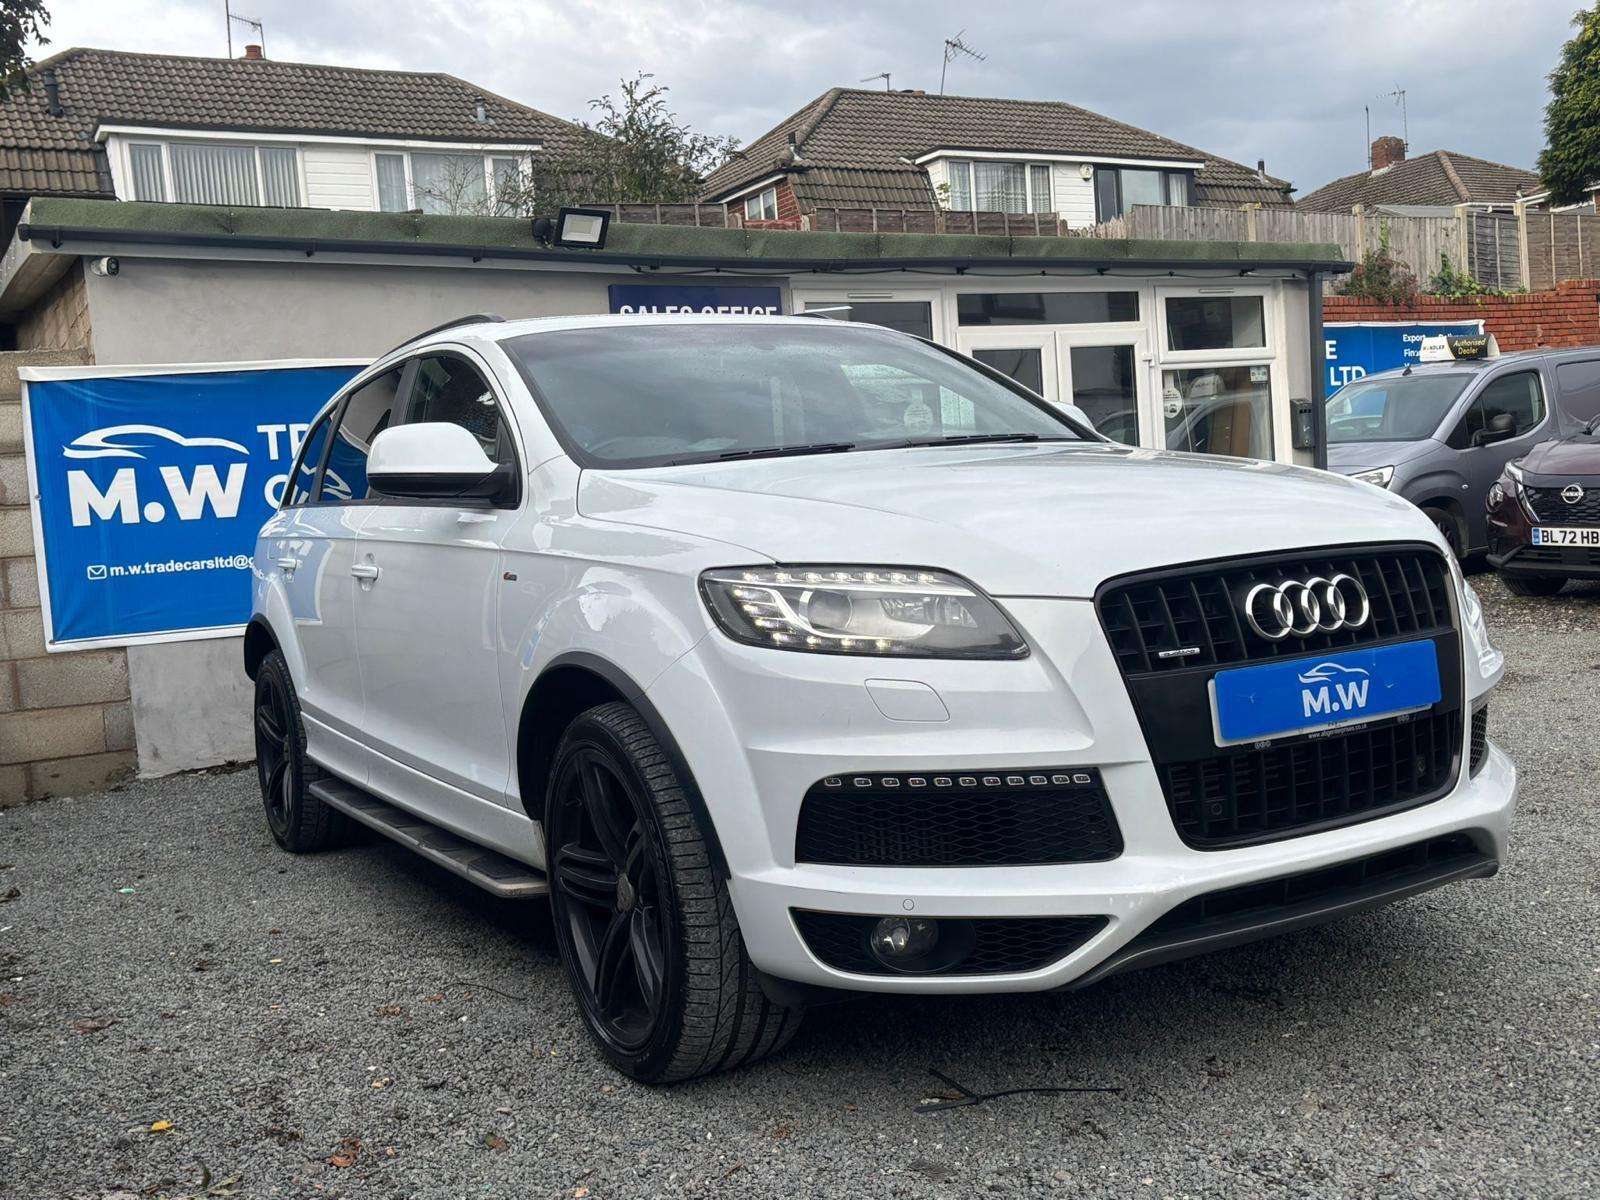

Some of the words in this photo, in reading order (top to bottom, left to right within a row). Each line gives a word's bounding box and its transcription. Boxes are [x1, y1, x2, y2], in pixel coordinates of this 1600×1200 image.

[1330, 365, 1367, 386] LTD
[67, 463, 248, 527] M.W
[1541, 530, 1577, 543] BL72
[1302, 679, 1370, 718] M.W
